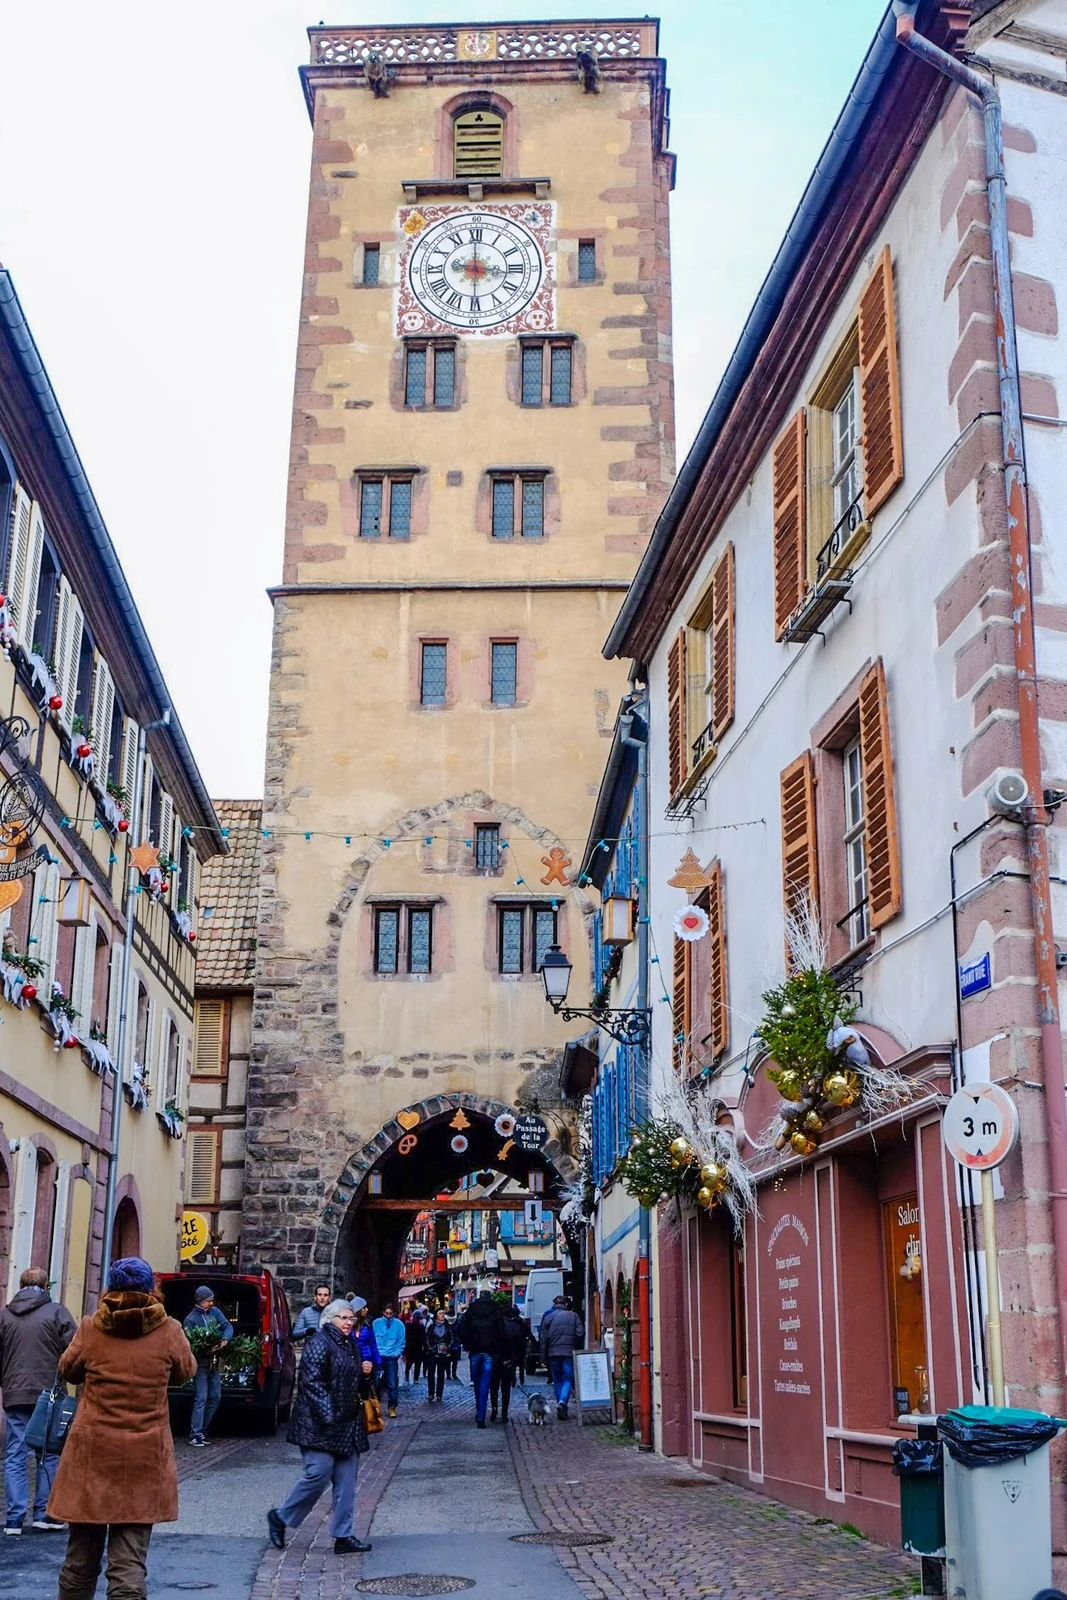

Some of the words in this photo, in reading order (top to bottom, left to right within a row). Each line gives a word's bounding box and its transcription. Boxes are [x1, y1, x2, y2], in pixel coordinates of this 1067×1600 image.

[442, 222, 453, 230] 55
[449, 233, 463, 246] XI
[470, 229, 482, 242] XII
[420, 241, 430, 250] 50
[434, 248, 449, 258] X
[503, 247, 519, 257] II
[412, 266, 420, 275] 45
[428, 264, 442, 274] IX
[509, 264, 523, 274] III
[430, 278, 449, 299] VIII
[503, 281, 517, 295] IV
[419, 291, 427, 300] 40
[522, 291, 532, 300] 20
[446, 293, 462, 309] VII
[492, 294, 502, 308] V
[440, 310, 450, 319] 35
[499, 311, 511, 320] 25
[9, 852, 38, 872] MUTUELLE
[10, 871, 17, 879] ET
[17, 868, 25, 877] DE
[516, 1124, 546, 1133] Passage
[964, 1118, 974, 1137] 3
[982, 1121, 997, 1135] m
